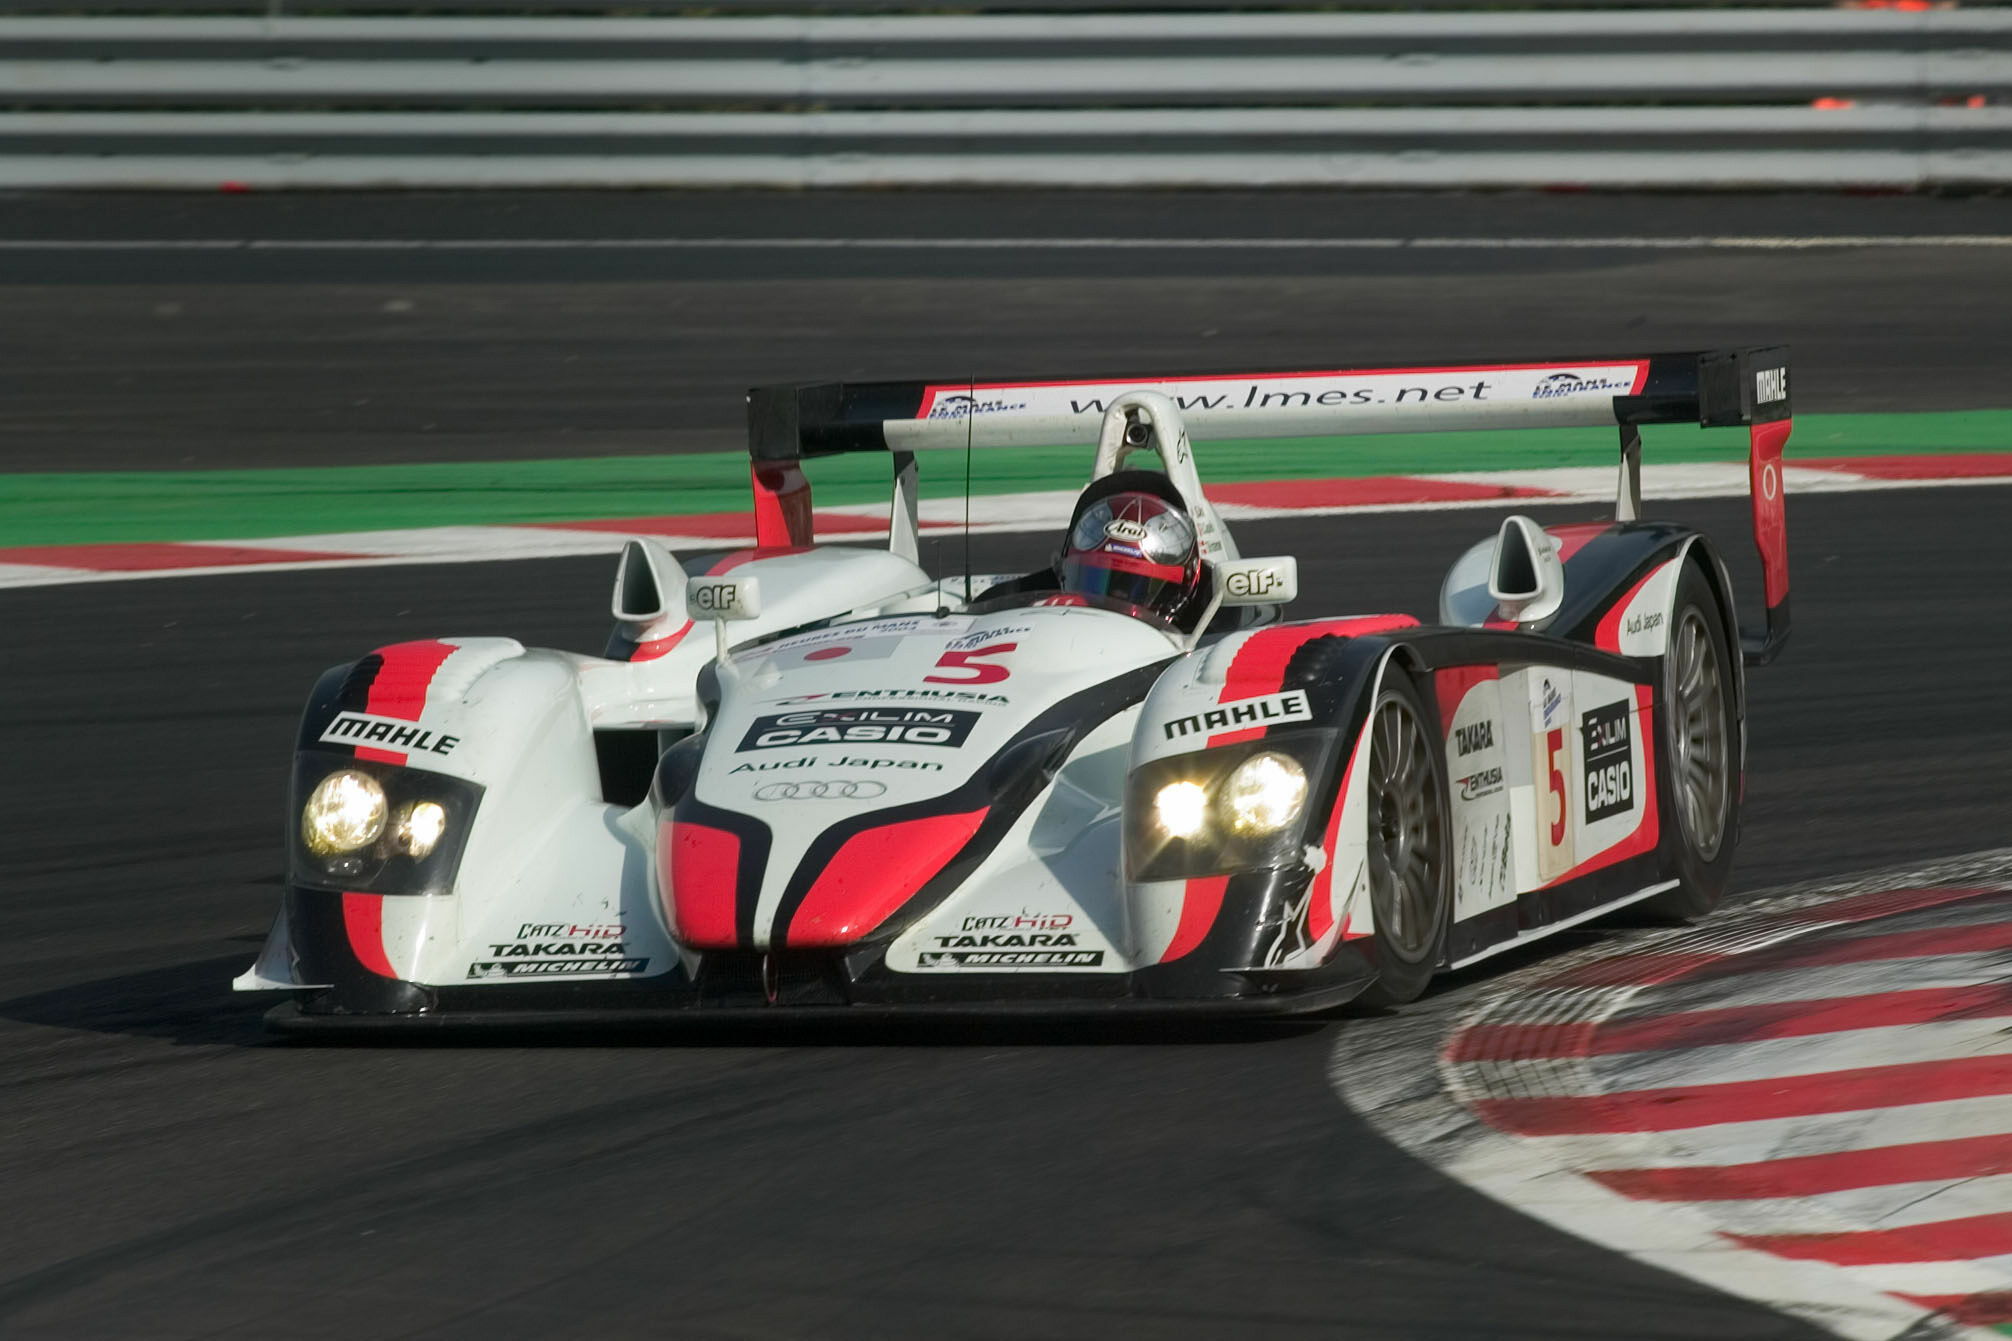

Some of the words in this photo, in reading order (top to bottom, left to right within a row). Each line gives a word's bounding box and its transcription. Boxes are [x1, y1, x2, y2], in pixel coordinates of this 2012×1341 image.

[1070, 381, 1492, 415] ww.lmes.net
[1756, 367, 1787, 404] MAHLE
[1111, 522, 1143, 536] Arai
[1227, 569, 1274, 595] elf
[697, 584, 736, 610] elf
[923, 642, 1018, 685] 5
[776, 711, 955, 727] EXILIM
[1164, 696, 1304, 740] MAHLE
[329, 717, 461, 756] MAHLE
[755, 725, 951, 747] CASIO
[1455, 720, 1494, 757] TAKARA
[728, 757, 816, 775] Audi
[828, 756, 944, 771] Japan
[1547, 728, 1567, 847] 5
[1588, 760, 1631, 812] CASIO
[489, 942, 628, 958] TAKARA
[934, 934, 1078, 948] TAKARA
[513, 960, 641, 974] MICHELIN
[962, 952, 1097, 964] MICHELIN
